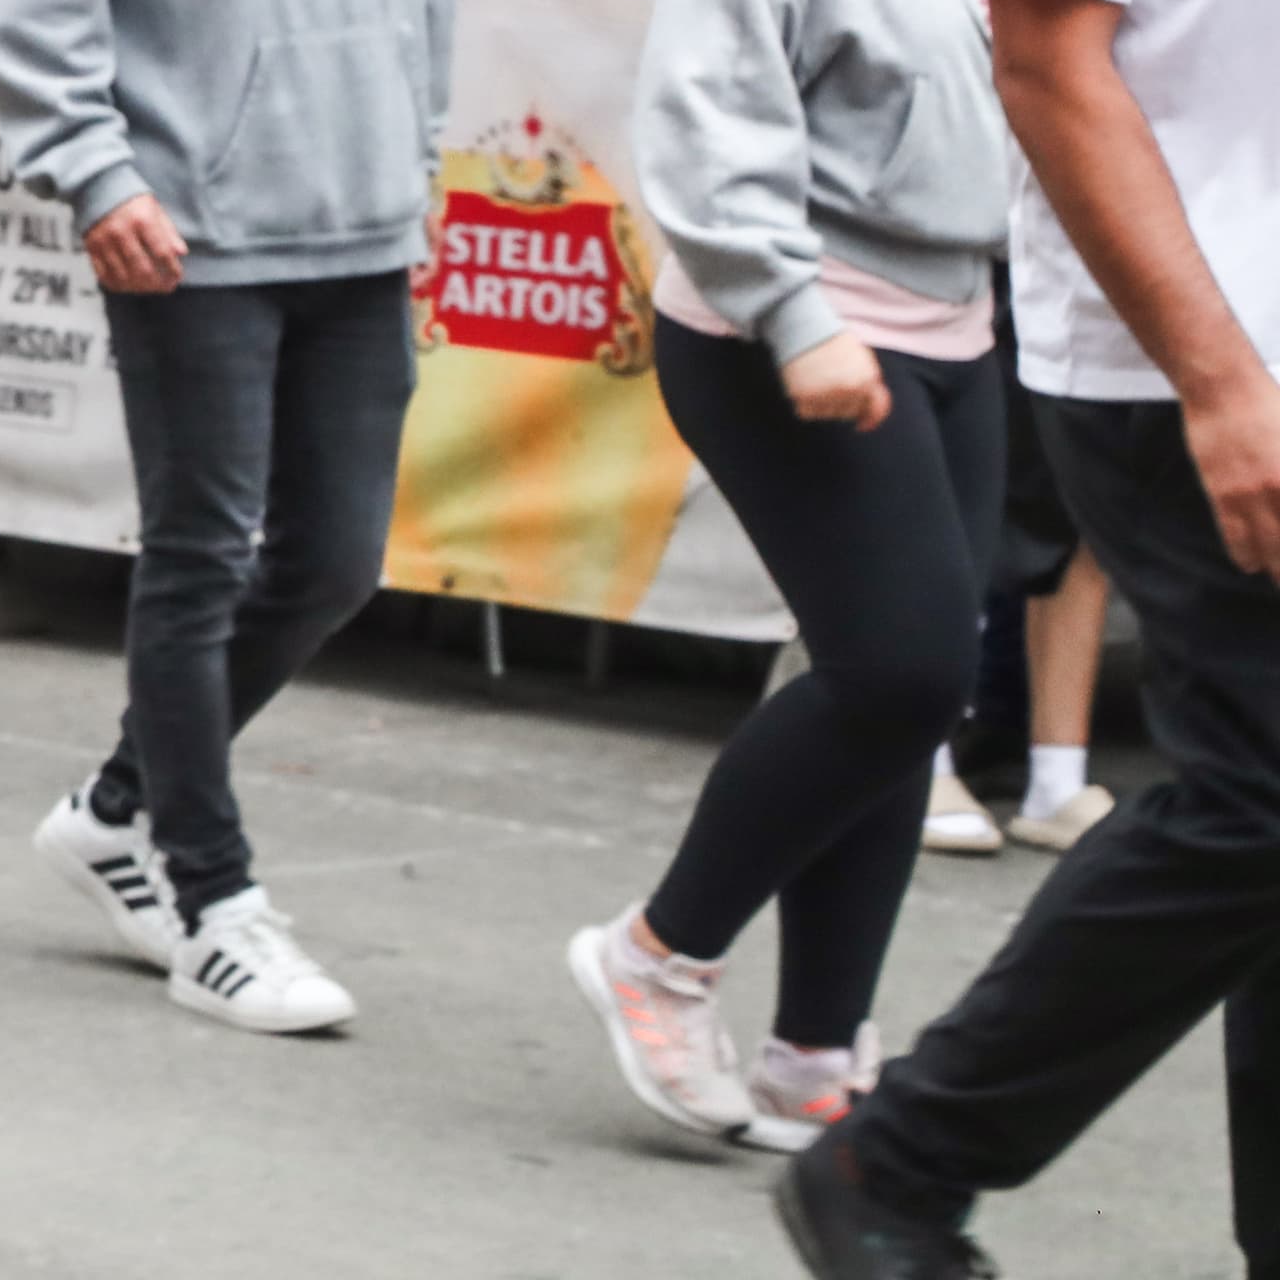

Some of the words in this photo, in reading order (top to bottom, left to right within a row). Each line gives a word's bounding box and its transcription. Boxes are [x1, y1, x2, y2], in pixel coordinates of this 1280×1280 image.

[444, 222, 609, 281] STELLA
[11, 266, 71, 308] 2PM
[440, 271, 608, 330] ARTOIS
